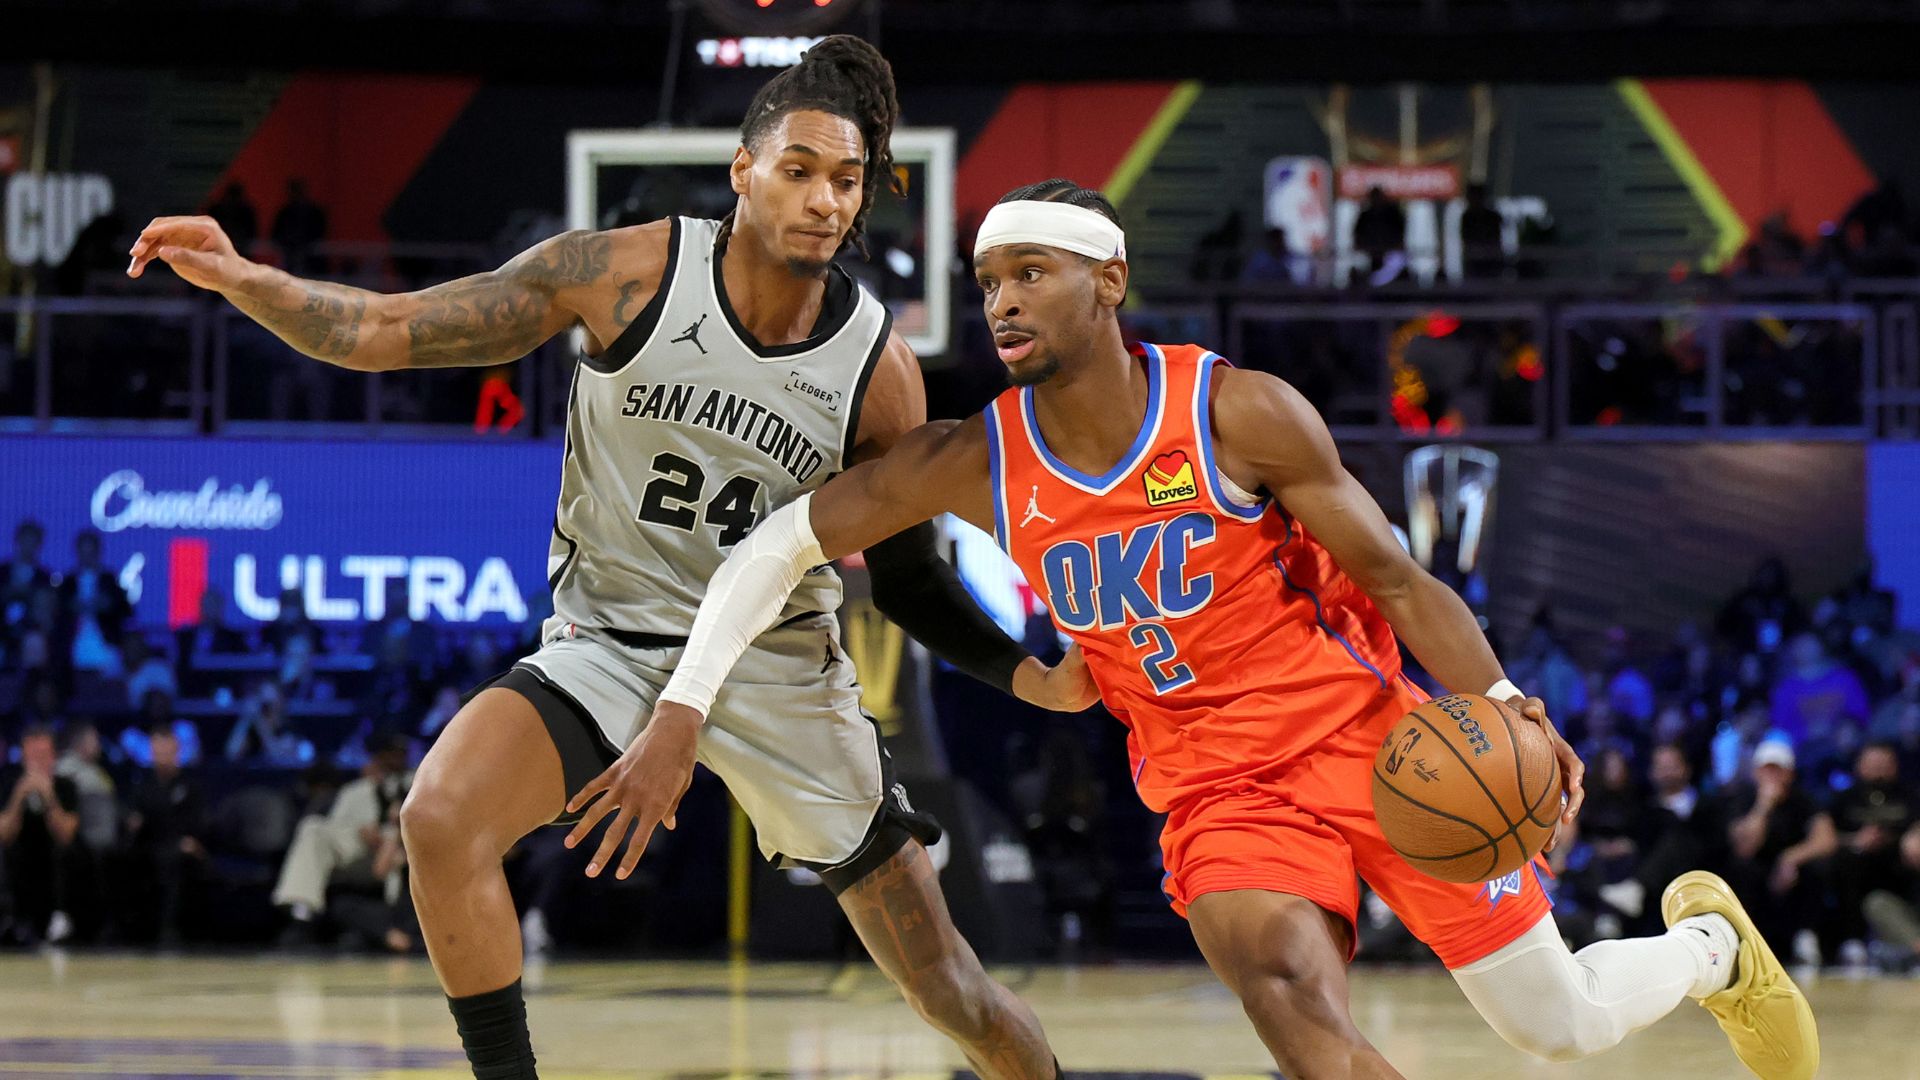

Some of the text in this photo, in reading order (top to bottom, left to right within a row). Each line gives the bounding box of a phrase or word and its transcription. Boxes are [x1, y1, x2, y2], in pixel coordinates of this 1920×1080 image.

[7, 172, 114, 266] CUP
[620, 382, 825, 486] SAN ANTONIO
[794, 379, 833, 403] LEDGER
[635, 450, 765, 549] 24
[234, 553, 529, 623] ULTRA
[1041, 511, 1217, 633] OKC
[1128, 622, 1197, 697] 2
